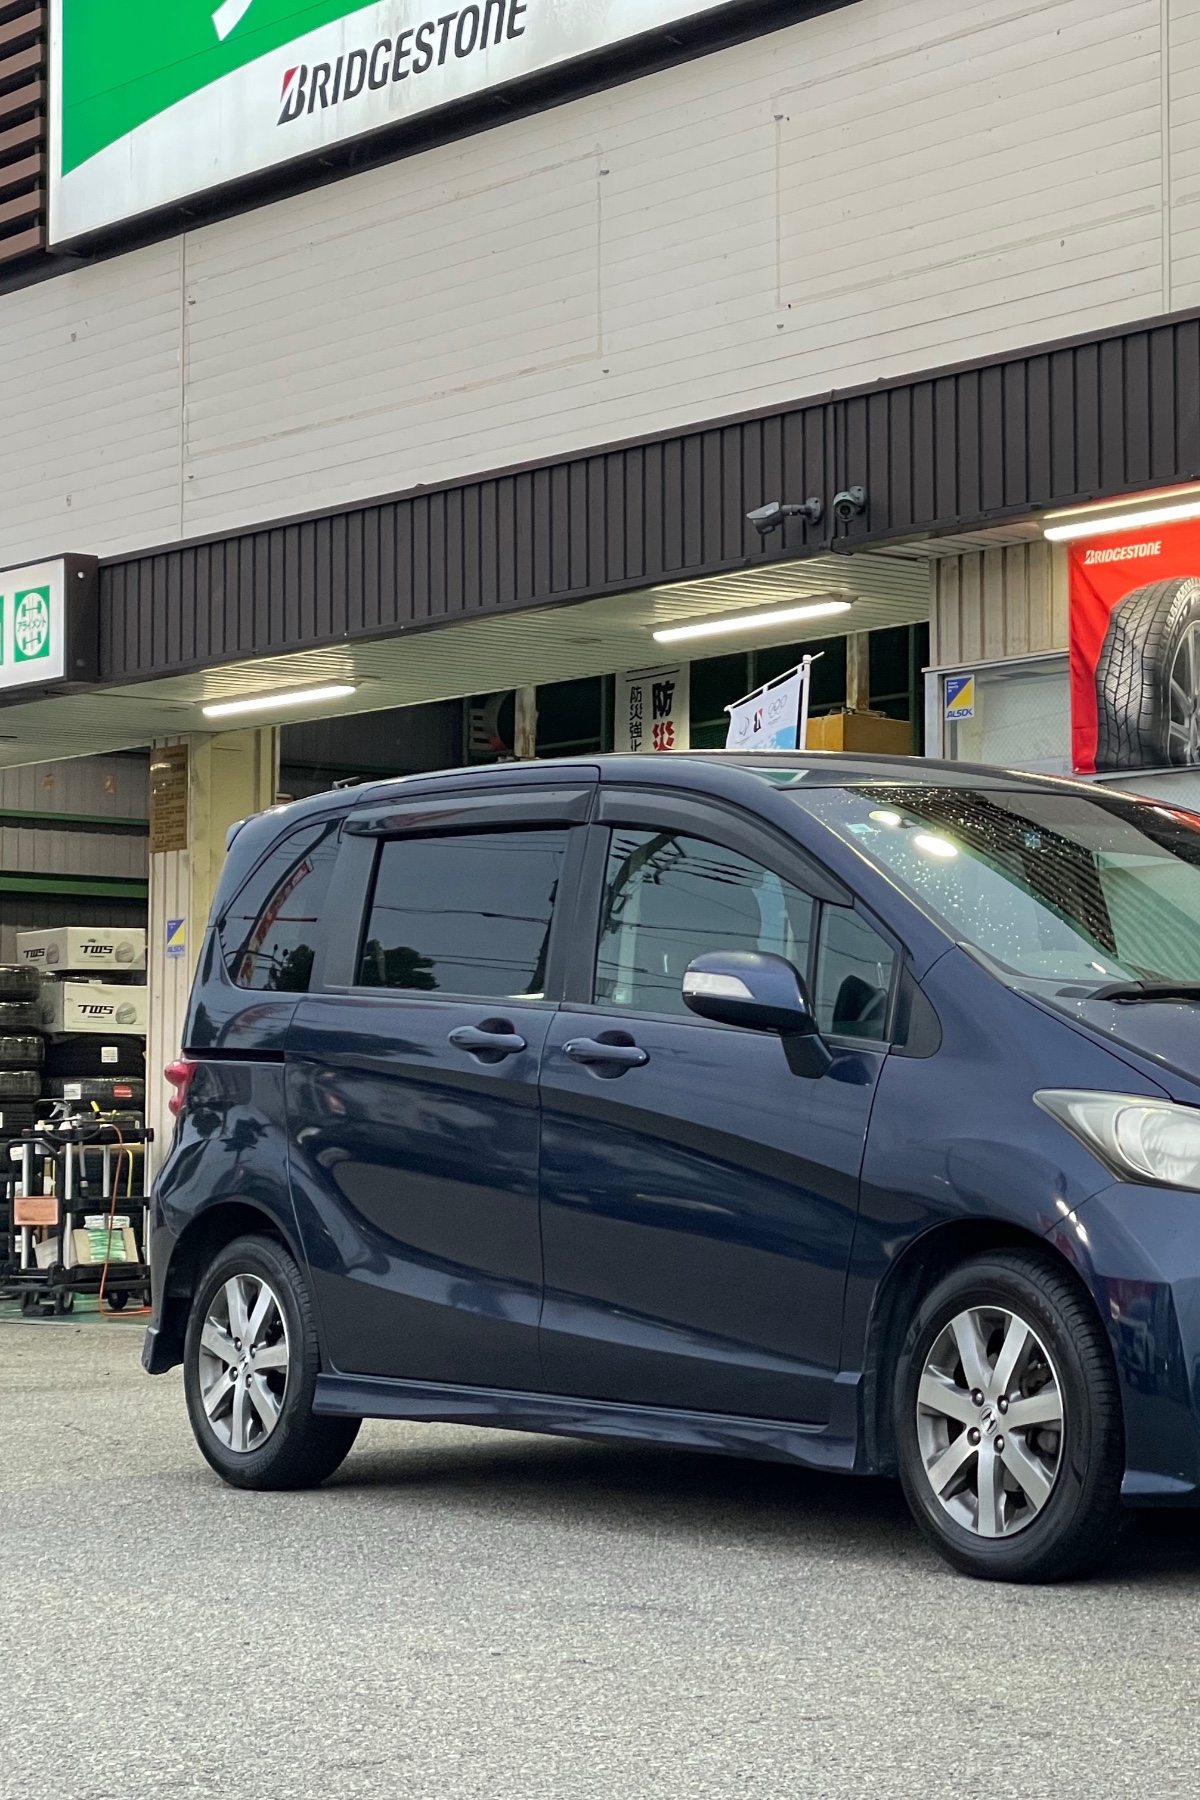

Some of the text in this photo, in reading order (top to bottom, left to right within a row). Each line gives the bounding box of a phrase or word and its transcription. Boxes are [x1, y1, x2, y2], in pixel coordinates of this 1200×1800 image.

[277, 0, 527, 126] BRIDGESTONE
[1083, 541, 1162, 565] BRIDGESTONE
[652, 680, 676, 751] 防災
[946, 708, 973, 719] ALSOK
[23, 948, 45, 959] TWS
[80, 945, 114, 954] TWS
[78, 1004, 114, 1015] TWS
